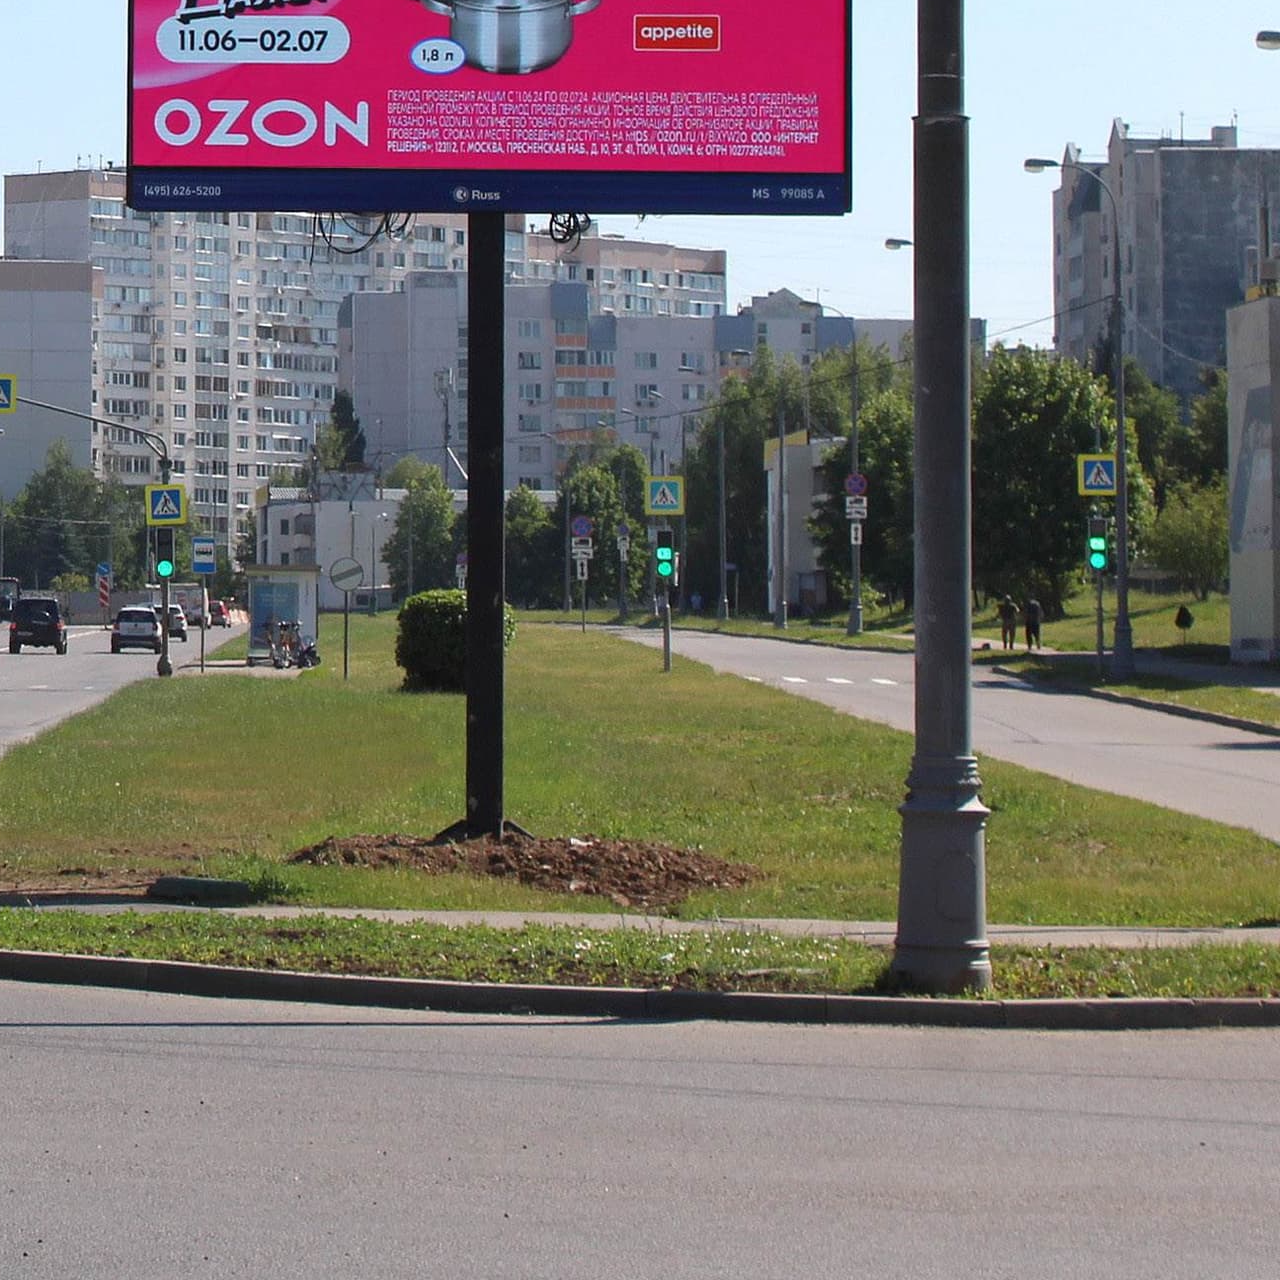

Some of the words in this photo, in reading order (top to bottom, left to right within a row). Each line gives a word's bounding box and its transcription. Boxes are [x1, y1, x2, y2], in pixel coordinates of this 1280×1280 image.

[640, 23, 714, 41] appetite
[421, 48, 440, 62] 1,8
[387, 90, 420, 102] ПЕРИОД
[422, 90, 476, 103] ПРОВЕДЕНИЯ
[154, 98, 369, 147] OZON
[750, 130, 772, 143] ООО
[506, 141, 566, 154] ПРЕСНЕНСКАЯ
[144, 185, 170, 197] (495)
[172, 185, 221, 197] 626-5200
[471, 189, 501, 200] Russ
[752, 188, 770, 199] MS
[781, 187, 814, 199] 99085
[816, 188, 825, 199] A
